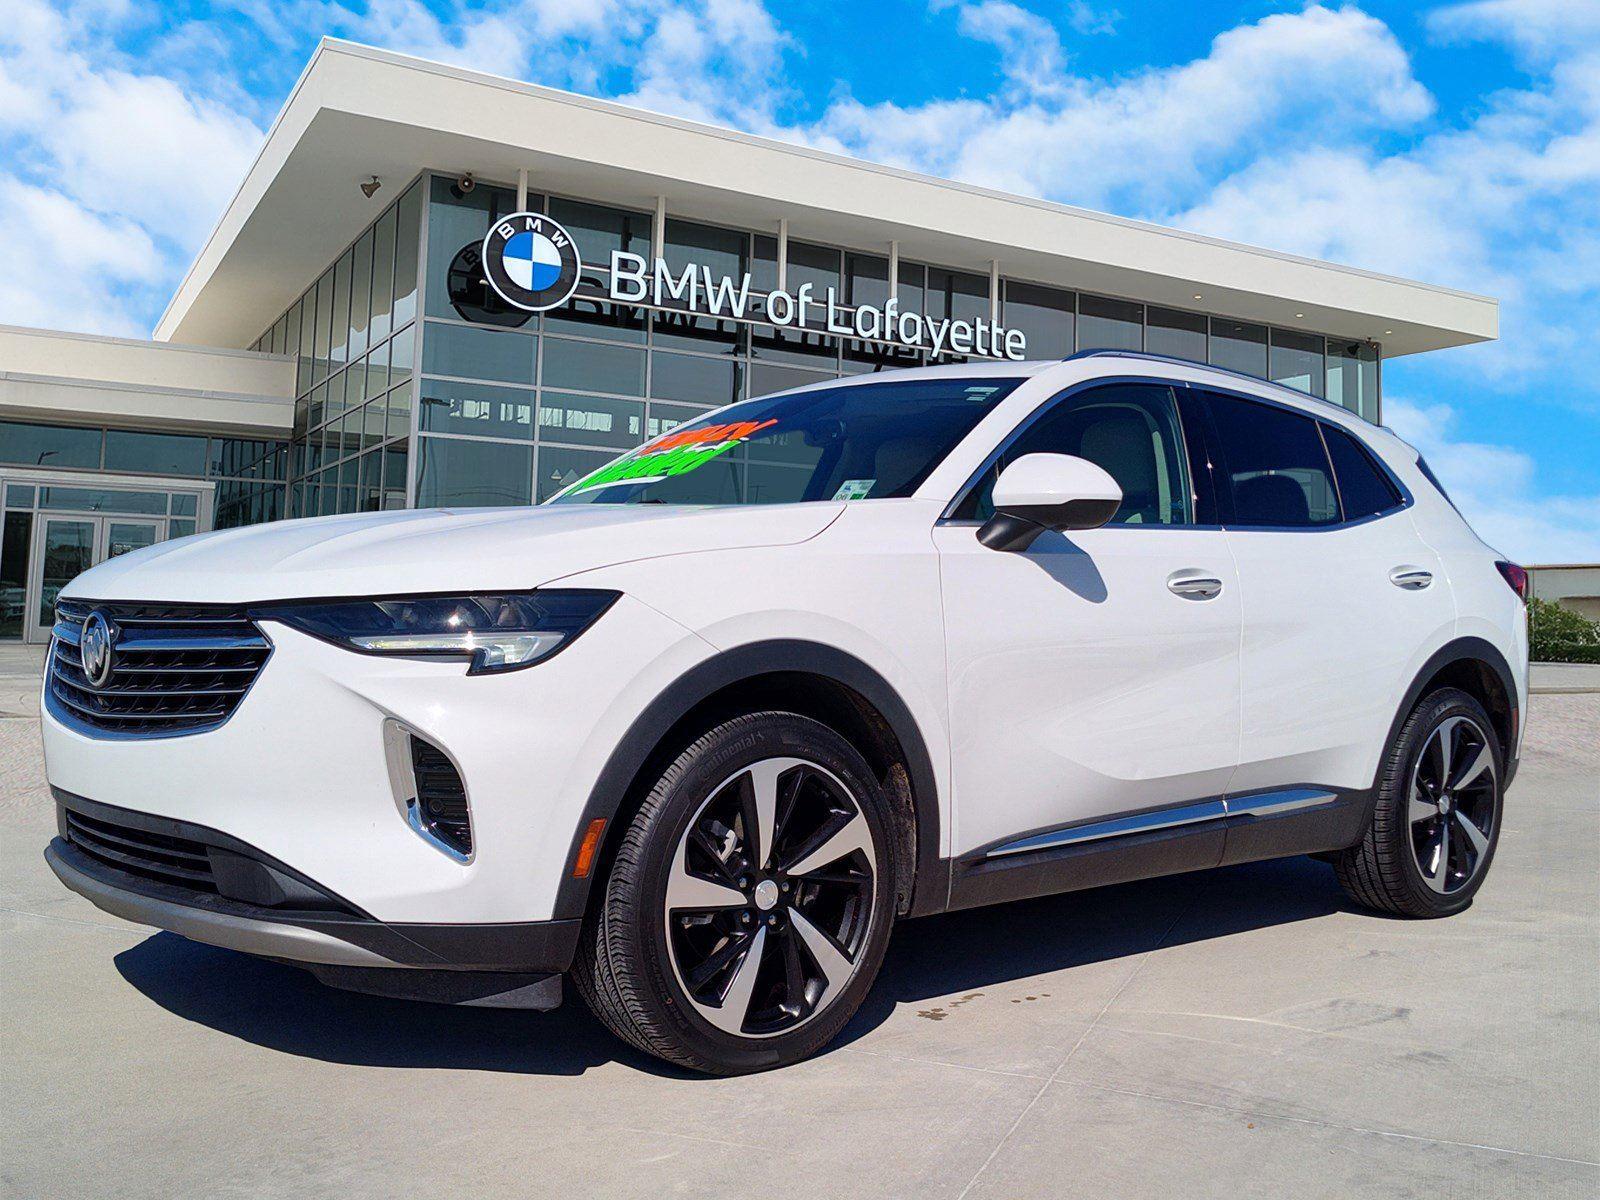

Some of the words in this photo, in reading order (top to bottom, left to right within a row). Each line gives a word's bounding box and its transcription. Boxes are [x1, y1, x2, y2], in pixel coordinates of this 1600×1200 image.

[497, 217, 569, 248] BMW
[610, 250, 751, 318] BMW
[766, 282, 813, 326] of
[827, 286, 1026, 361] Lafayette
